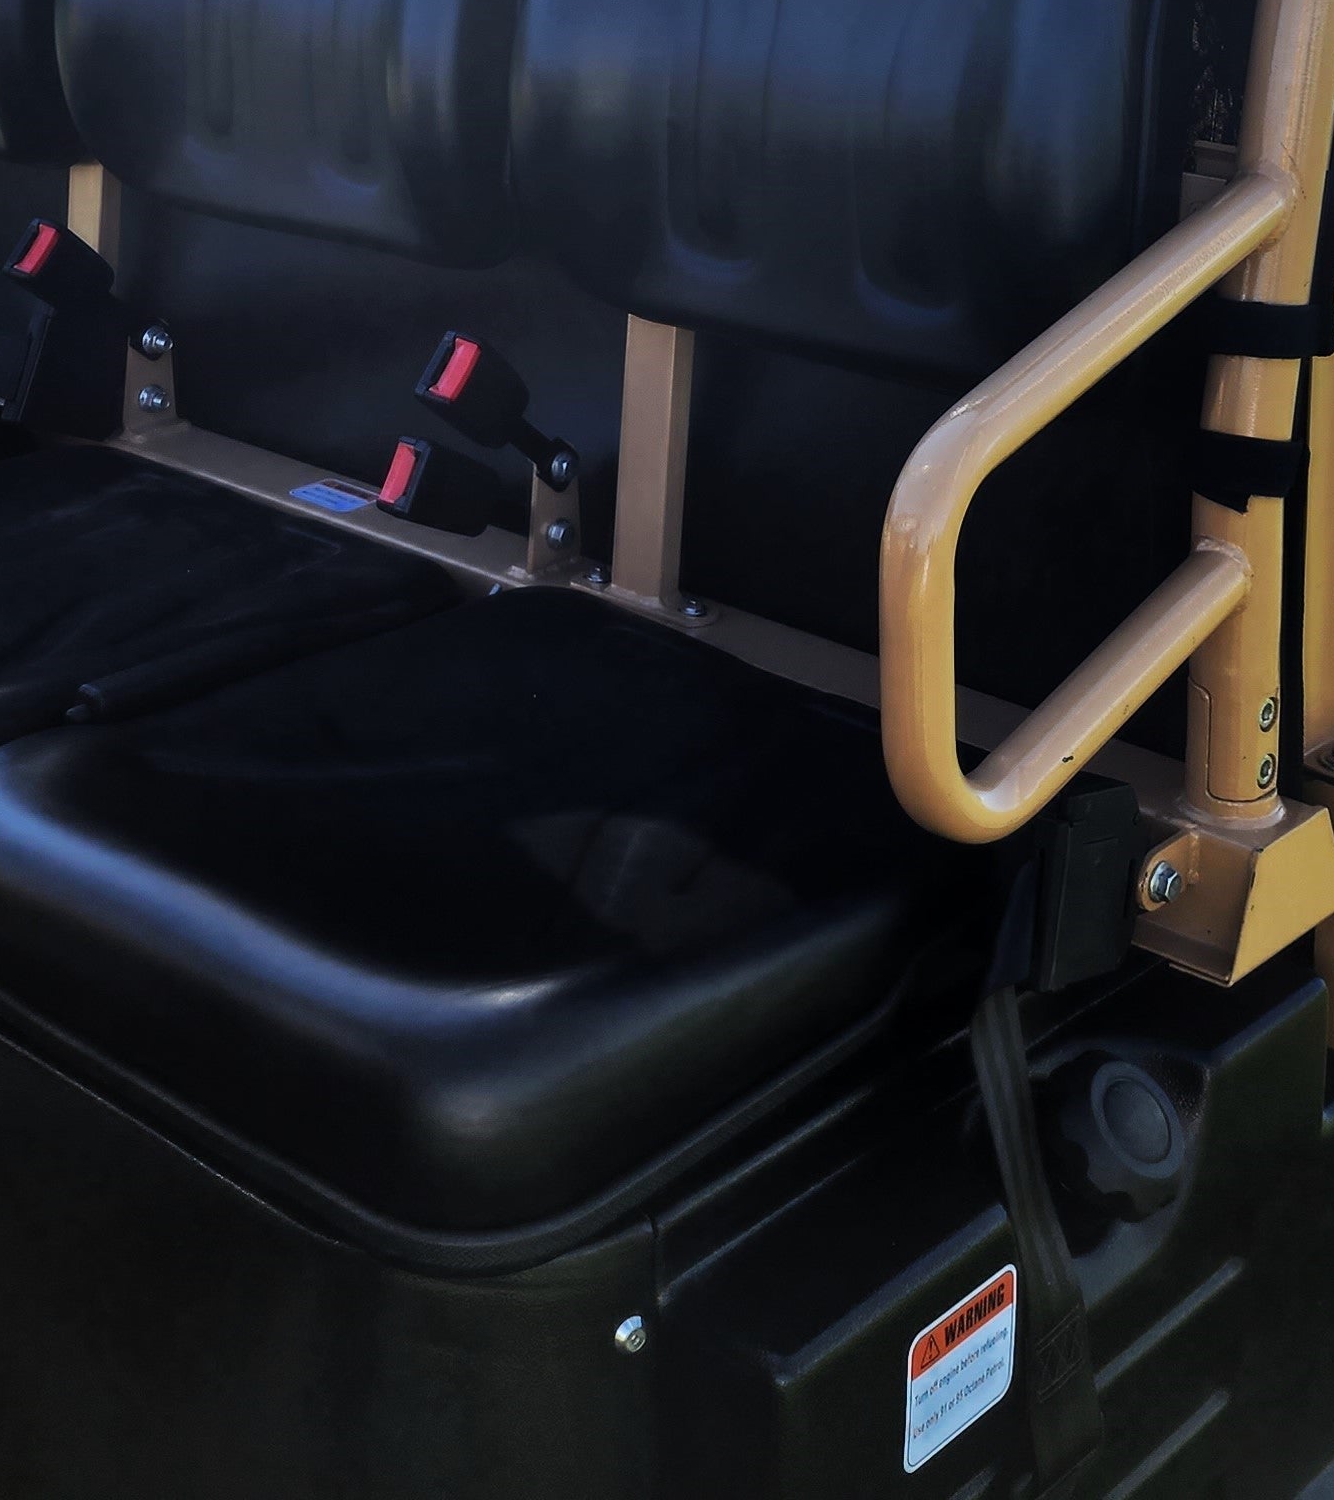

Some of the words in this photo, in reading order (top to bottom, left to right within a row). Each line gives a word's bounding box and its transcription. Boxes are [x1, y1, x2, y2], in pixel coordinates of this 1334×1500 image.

[945, 1283, 1005, 1348] WARNING
[914, 1389, 929, 1407] Turn
[929, 1380, 939, 1396] off
[939, 1364, 960, 1389] engine
[960, 1349, 980, 1372] before
[926, 1410, 939, 1429] only
[964, 1374, 985, 1397] Octane
